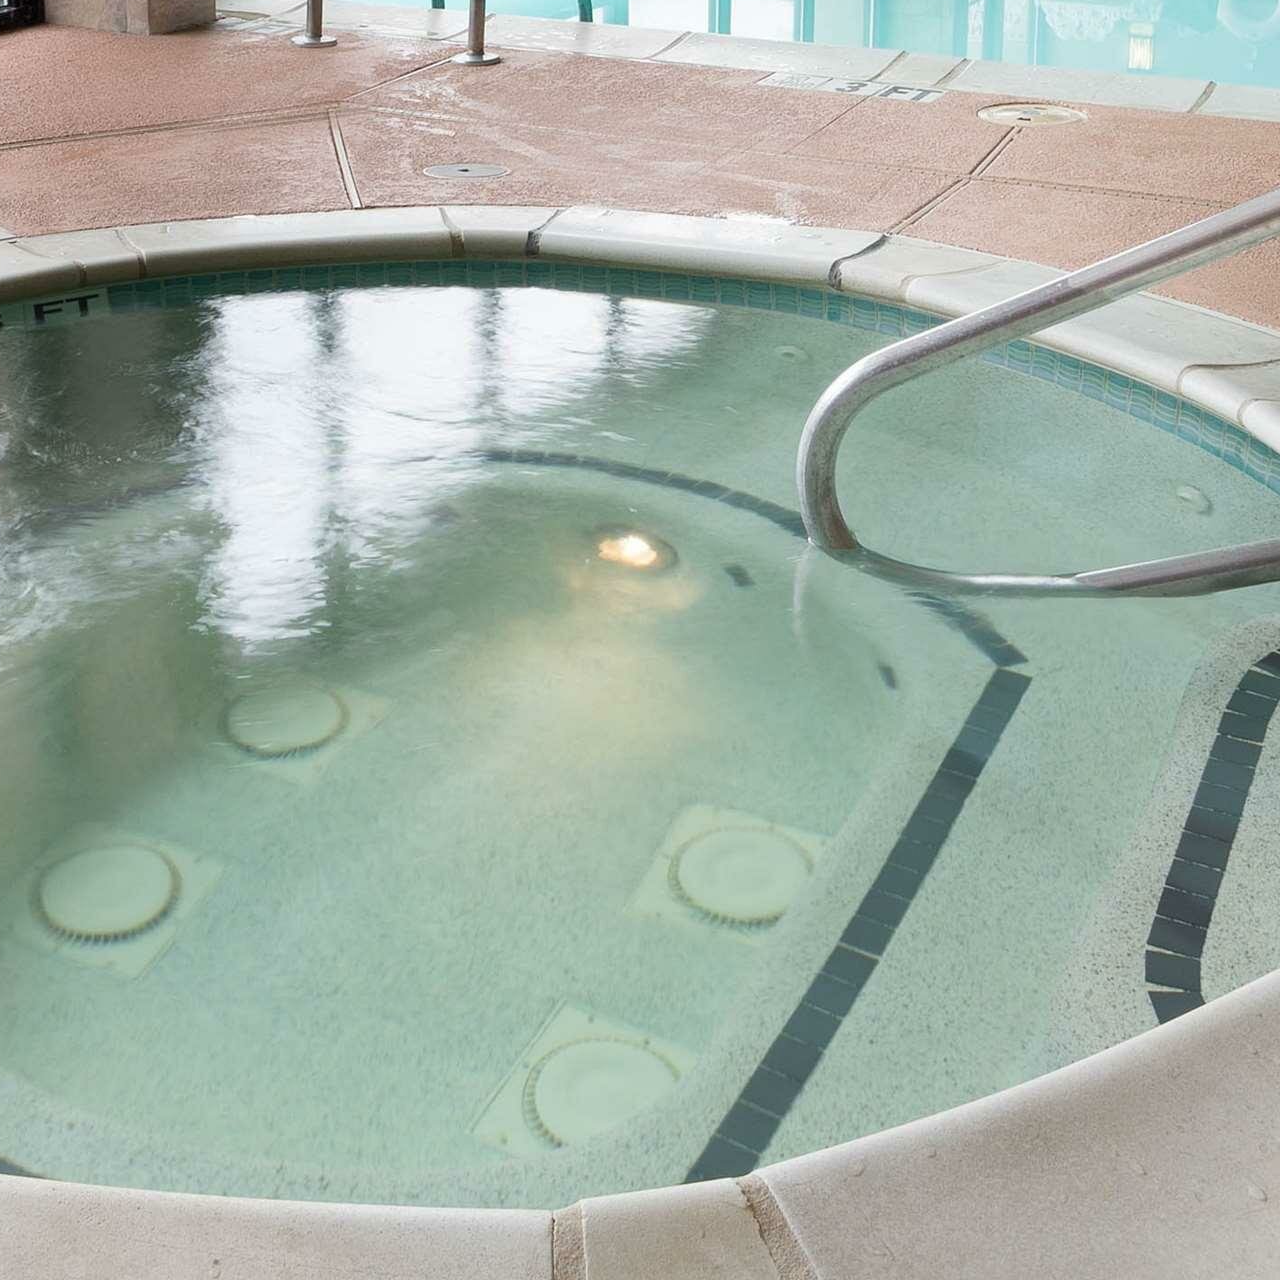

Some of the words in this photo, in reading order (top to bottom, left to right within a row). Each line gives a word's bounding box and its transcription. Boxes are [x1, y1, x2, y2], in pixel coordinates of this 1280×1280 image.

[835, 81, 868, 93] 3
[879, 85, 943, 102] FT
[33, 293, 100, 325] FT
